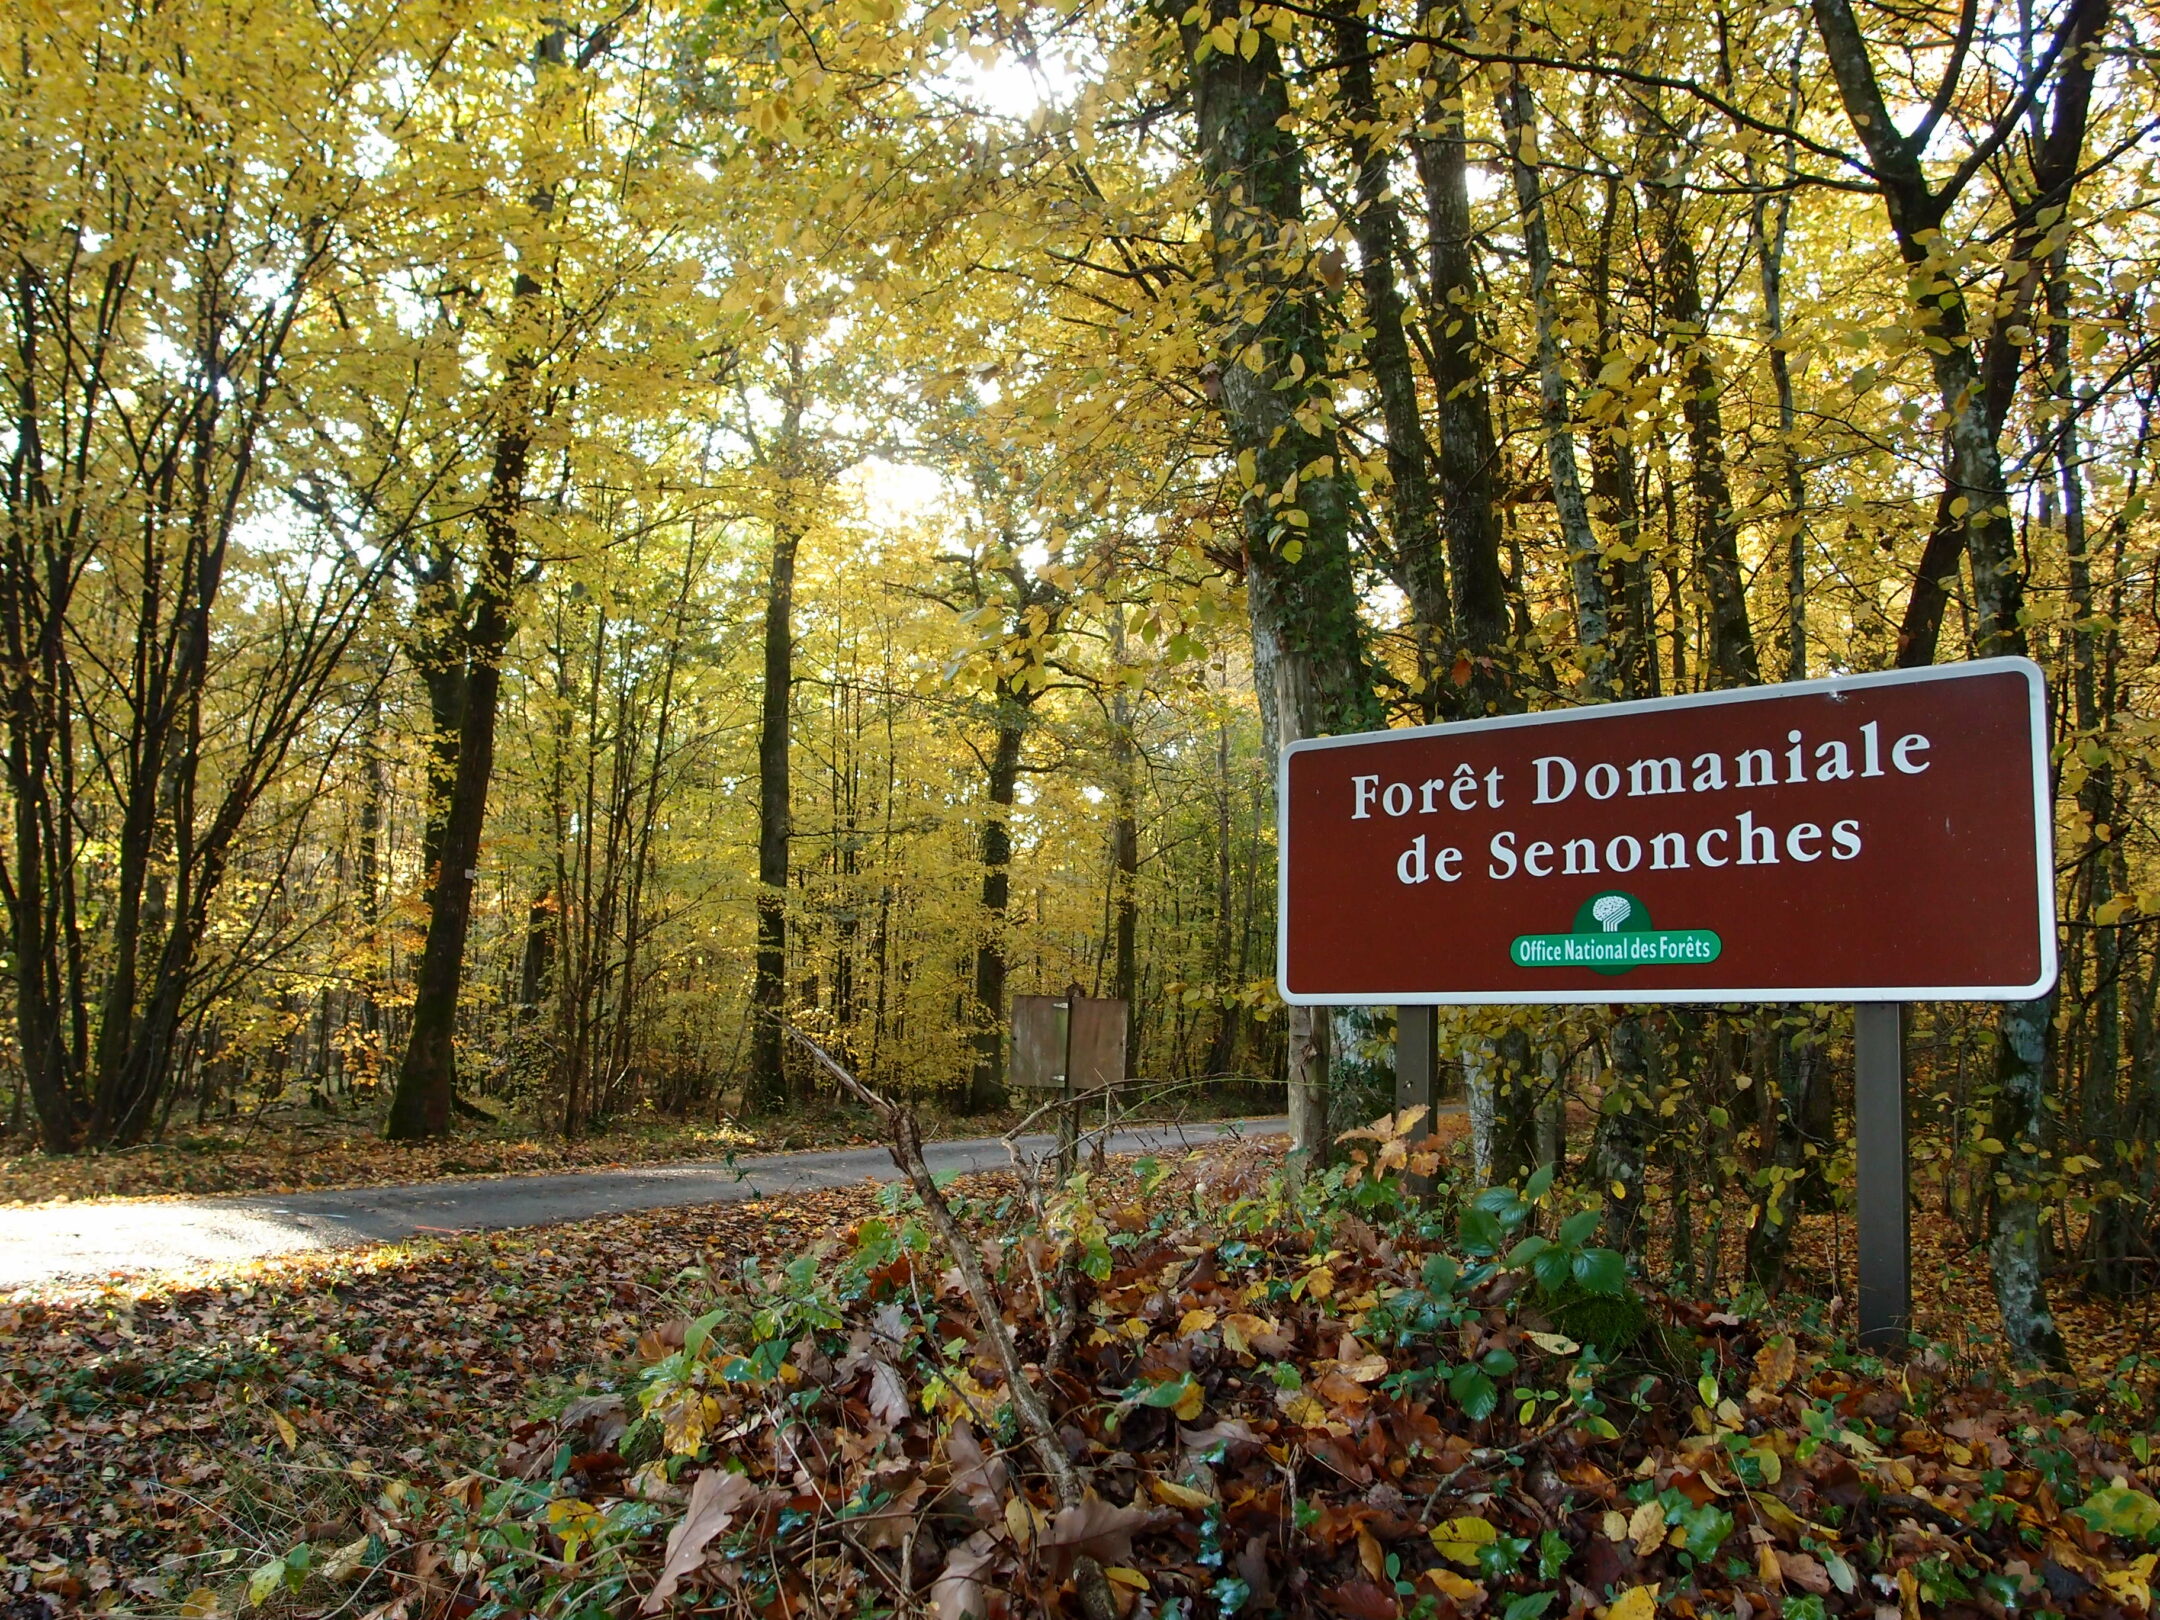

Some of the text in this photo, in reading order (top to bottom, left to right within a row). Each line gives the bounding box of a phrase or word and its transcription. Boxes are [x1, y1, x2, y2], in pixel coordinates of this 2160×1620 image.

[1351, 720, 1931, 819] Forêt Domaniale
[1397, 810, 1862, 884] de Senonches
[1519, 935, 1710, 961] Office National des Forêts
